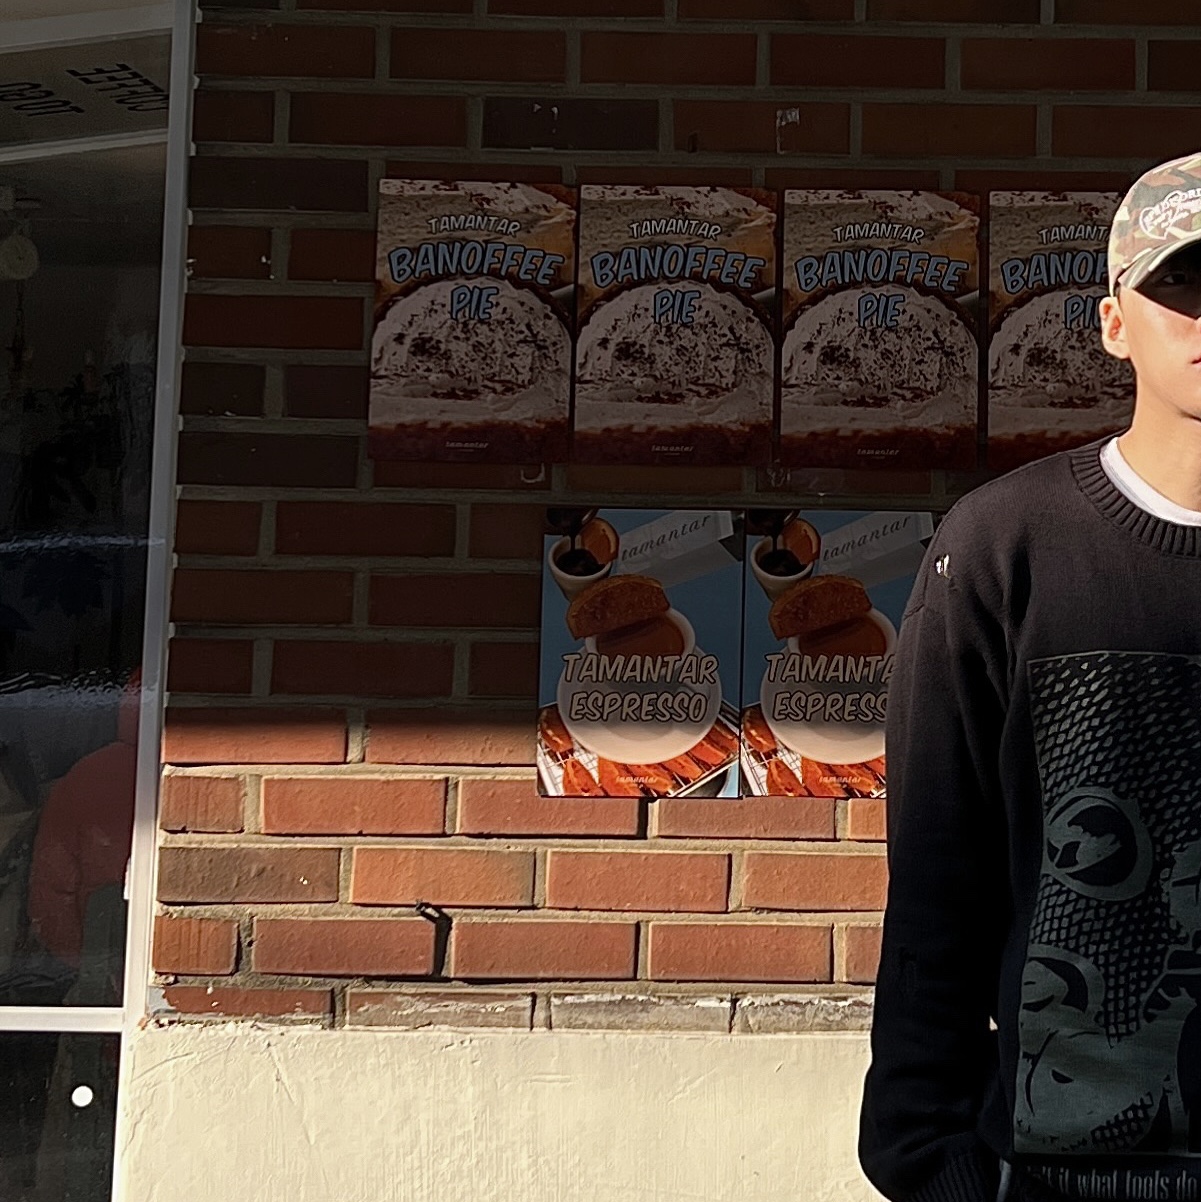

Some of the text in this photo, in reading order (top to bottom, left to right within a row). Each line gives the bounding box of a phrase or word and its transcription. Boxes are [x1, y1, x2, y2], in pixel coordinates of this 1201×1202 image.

[427, 214, 521, 237] TAMANTAR
[629, 218, 722, 240] TAMANTAR
[833, 222, 925, 245] TAMANTAR
[1038, 223, 1109, 245] TAMANT
[387, 241, 565, 285] BANOFFEE
[590, 245, 766, 289] BANOFFEE
[794, 249, 969, 293] BANOFFEE
[1001, 250, 1108, 295] BANOF
[450, 285, 500, 321] PIE
[653, 289, 702, 325] PIE
[857, 293, 906, 329] PIE
[621, 514, 711, 562] tamantar
[823, 515, 911, 562] tamantar
[561, 652, 719, 685] TAMANTAR
[765, 652, 895, 685] TAMANTA
[569, 691, 708, 723] ESPRESSO
[774, 691, 887, 723] ESPRESS
[1077, 1168, 1119, 1200] what
[1176, 1169, 1198, 1201] do
